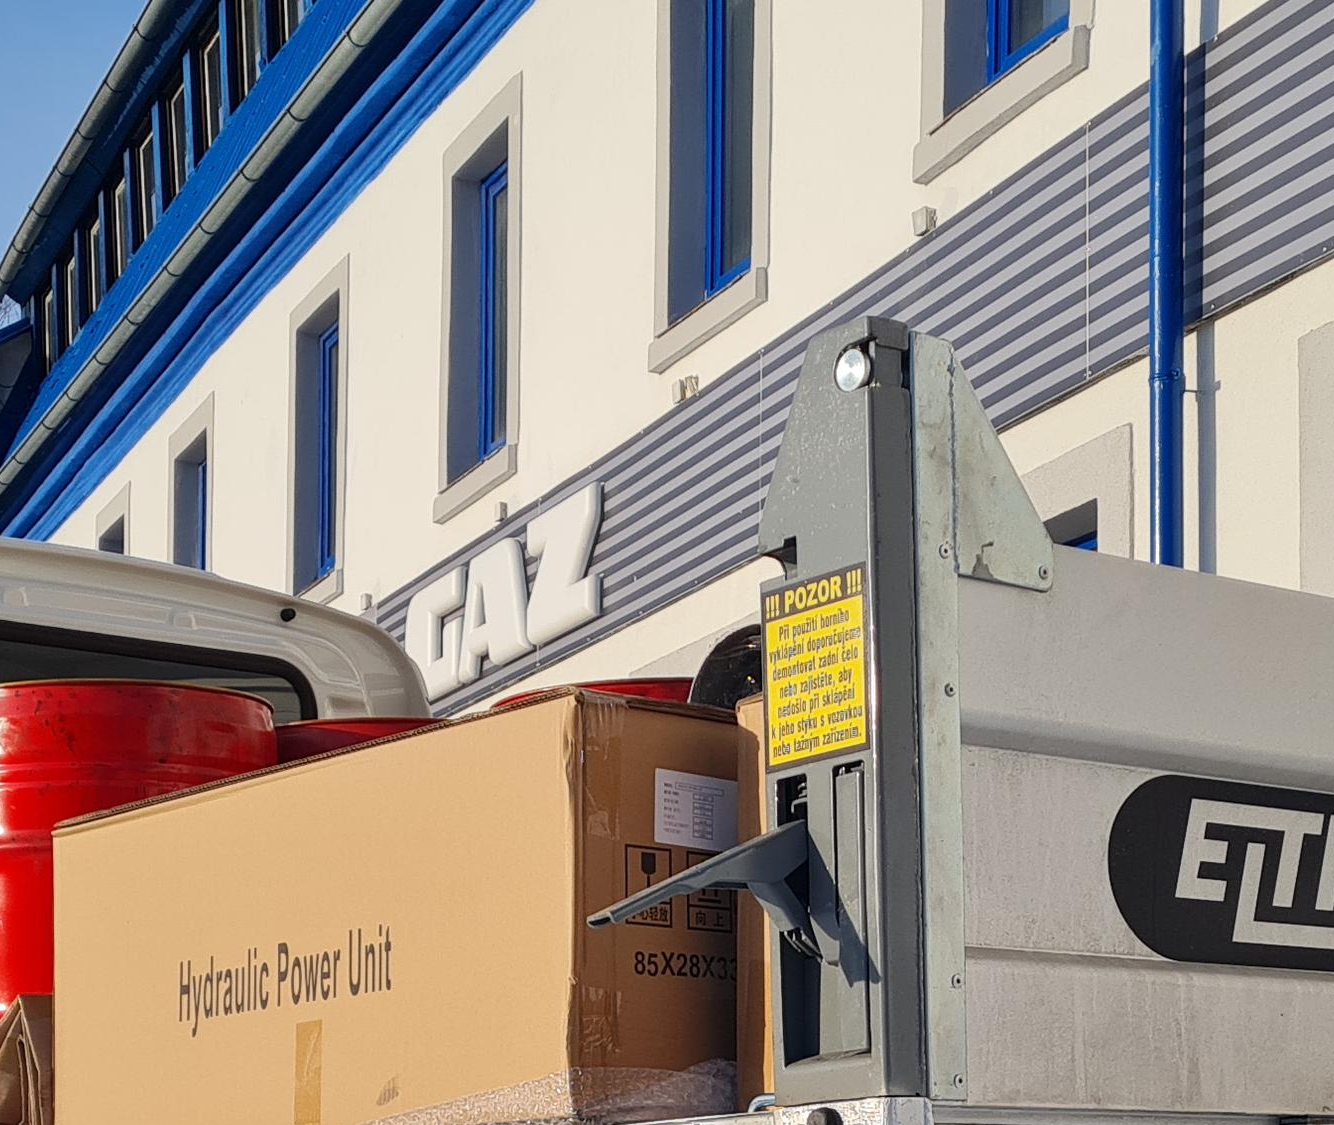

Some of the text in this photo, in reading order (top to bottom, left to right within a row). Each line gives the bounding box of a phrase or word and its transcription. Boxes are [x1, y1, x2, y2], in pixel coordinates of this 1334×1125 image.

[405, 481, 604, 700] GAZ
[785, 575, 842, 613] POZOR
[779, 624, 790, 641] Při
[793, 614, 818, 642] použití
[842, 643, 859, 662] čelo
[838, 666, 853, 684] aby
[809, 693, 820, 714] při
[779, 720, 795, 741] jeho
[178, 923, 392, 1038] Hydraulic Power Unit
